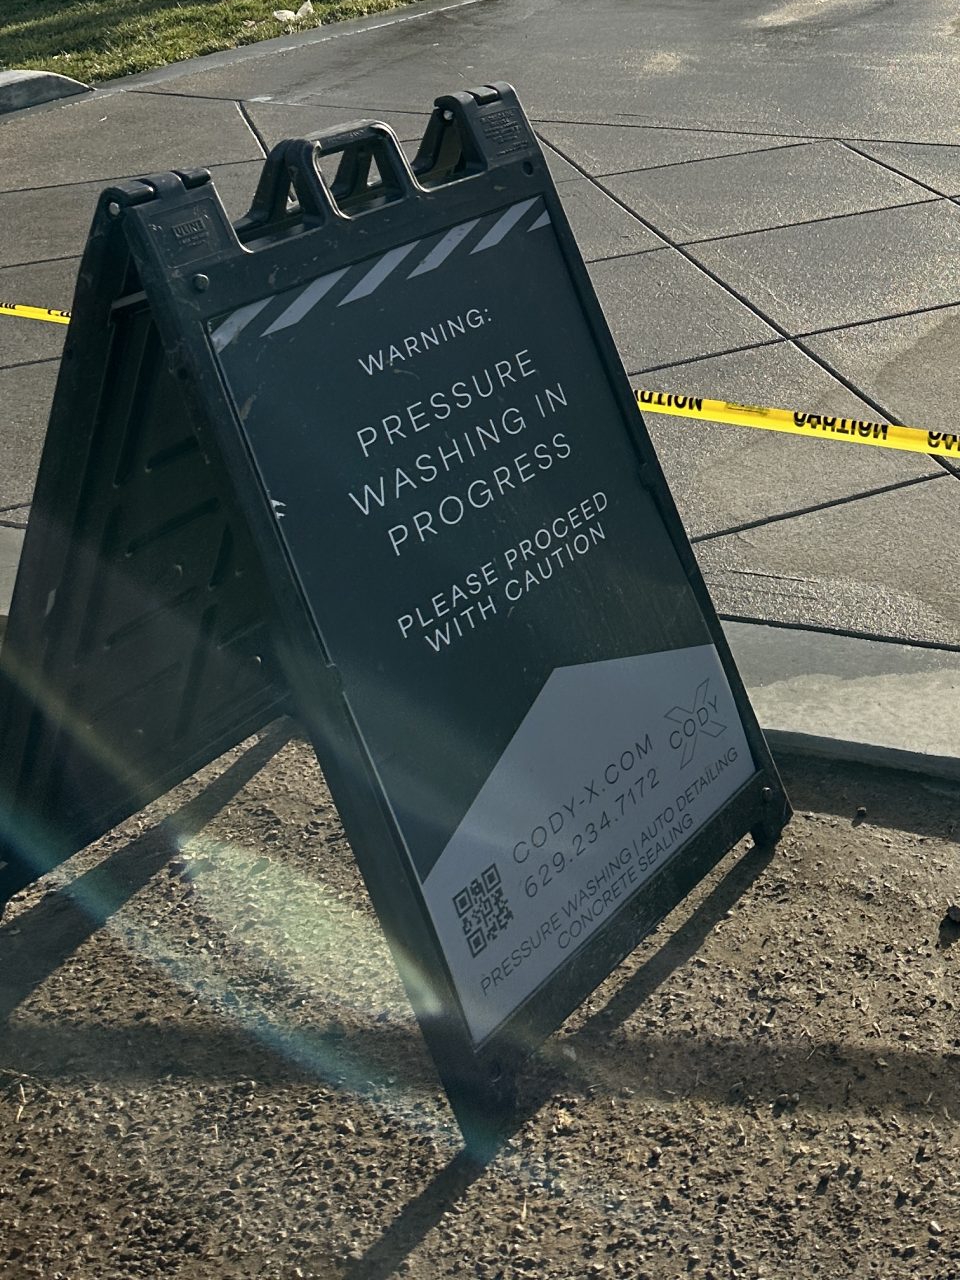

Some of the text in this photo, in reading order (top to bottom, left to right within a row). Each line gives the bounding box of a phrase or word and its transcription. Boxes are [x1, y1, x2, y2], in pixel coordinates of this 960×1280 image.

[356, 349, 536, 458] PRESSURE
[358, 308, 492, 376] WARNING:
[348, 382, 568, 516] WASHING IN
[387, 432, 571, 557] PROGRESS
[397, 491, 608, 639] PLEASE PROCEED
[424, 521, 606, 652] WITH CAUTION
[669, 695, 719, 750] CODY
[512, 733, 653, 864] CODY-X.COM
[524, 768, 660, 898] 629.234.7172
[479, 912, 562, 997] PRESSURE
[561, 847, 632, 918] WASHING
[640, 806, 675, 849] AUTO
[675, 746, 739, 812] DETAILING
[557, 812, 694, 950] CONCRETE SEALING
